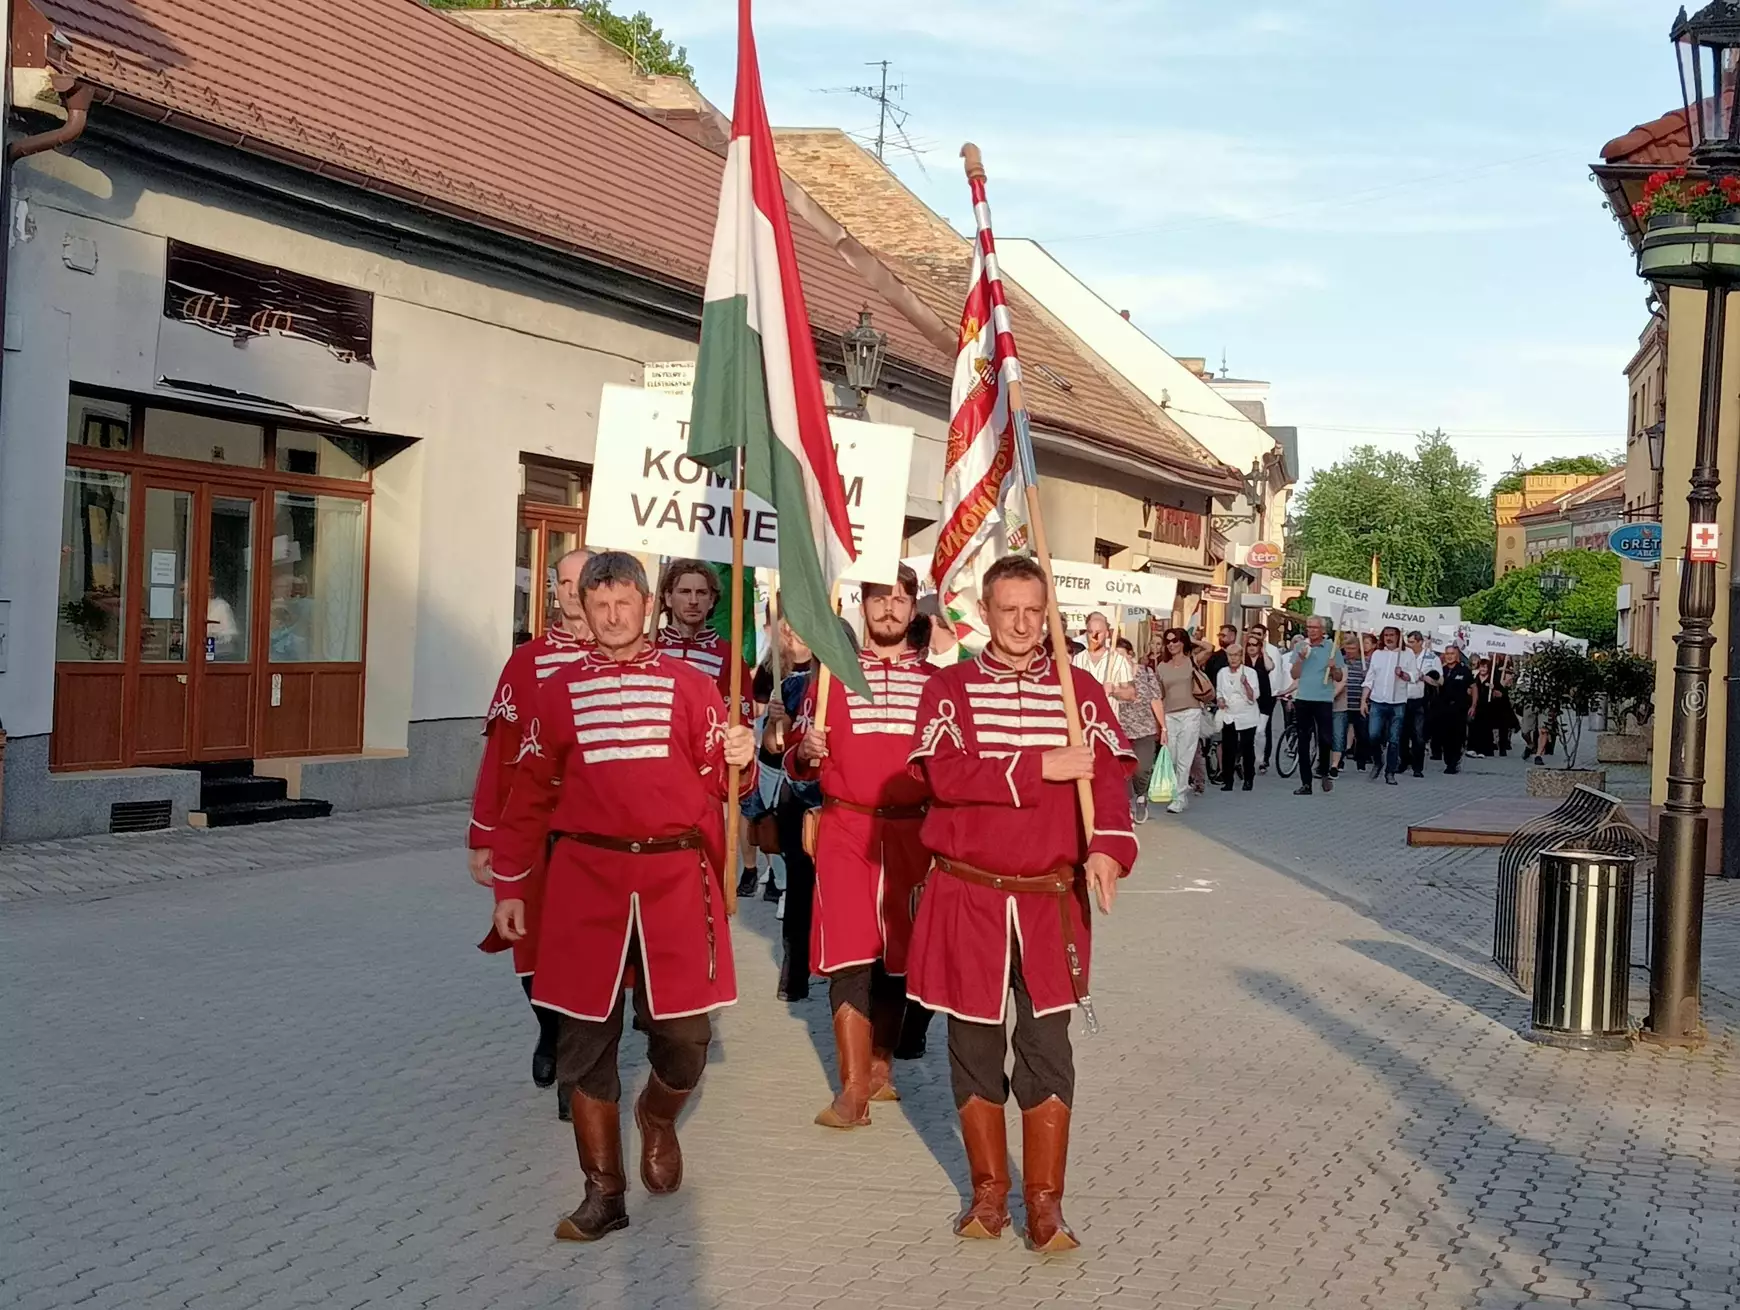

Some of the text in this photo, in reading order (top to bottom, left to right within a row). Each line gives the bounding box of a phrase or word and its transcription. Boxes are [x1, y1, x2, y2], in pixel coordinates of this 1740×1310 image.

[1621, 539, 1661, 550] GRET
[1327, 585, 1369, 602] GELLÉR
[1381, 611, 1425, 623] NASZVAD
